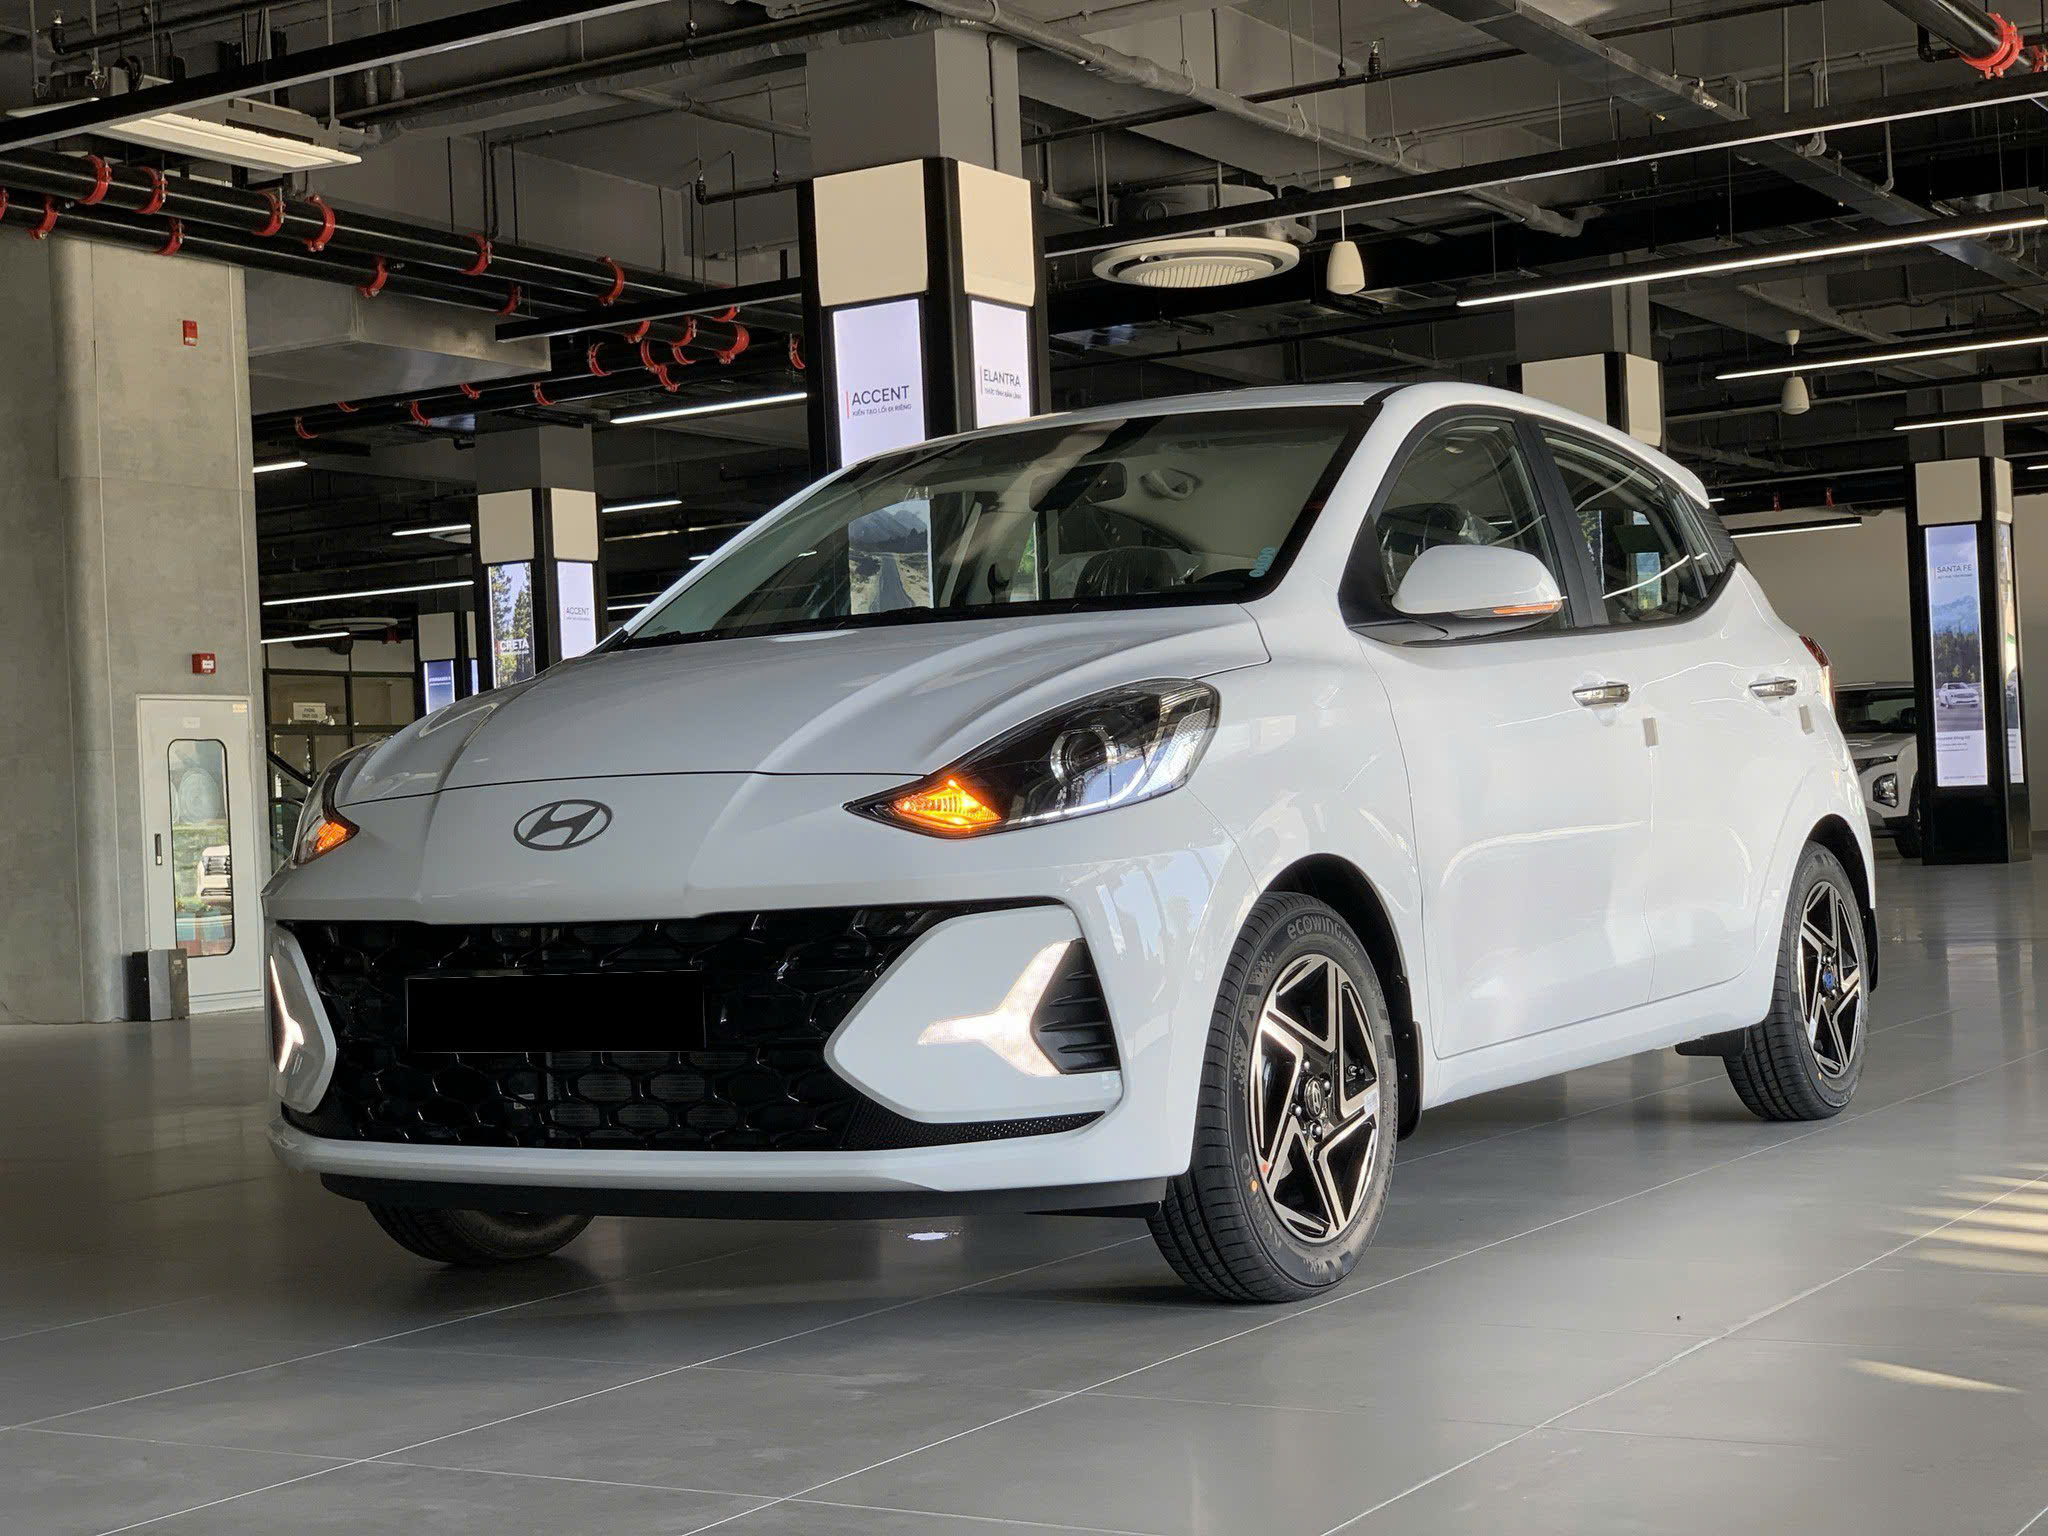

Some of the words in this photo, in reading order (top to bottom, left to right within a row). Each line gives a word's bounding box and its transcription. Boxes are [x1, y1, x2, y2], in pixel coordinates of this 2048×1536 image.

[983, 368, 1021, 388] ELANTRA
[852, 384, 910, 406] ACCENT
[1937, 565, 1962, 573] SANTA
[1963, 563, 1972, 571] FE
[566, 606, 590, 616] ACCENT
[501, 638, 530, 651] CRETA
